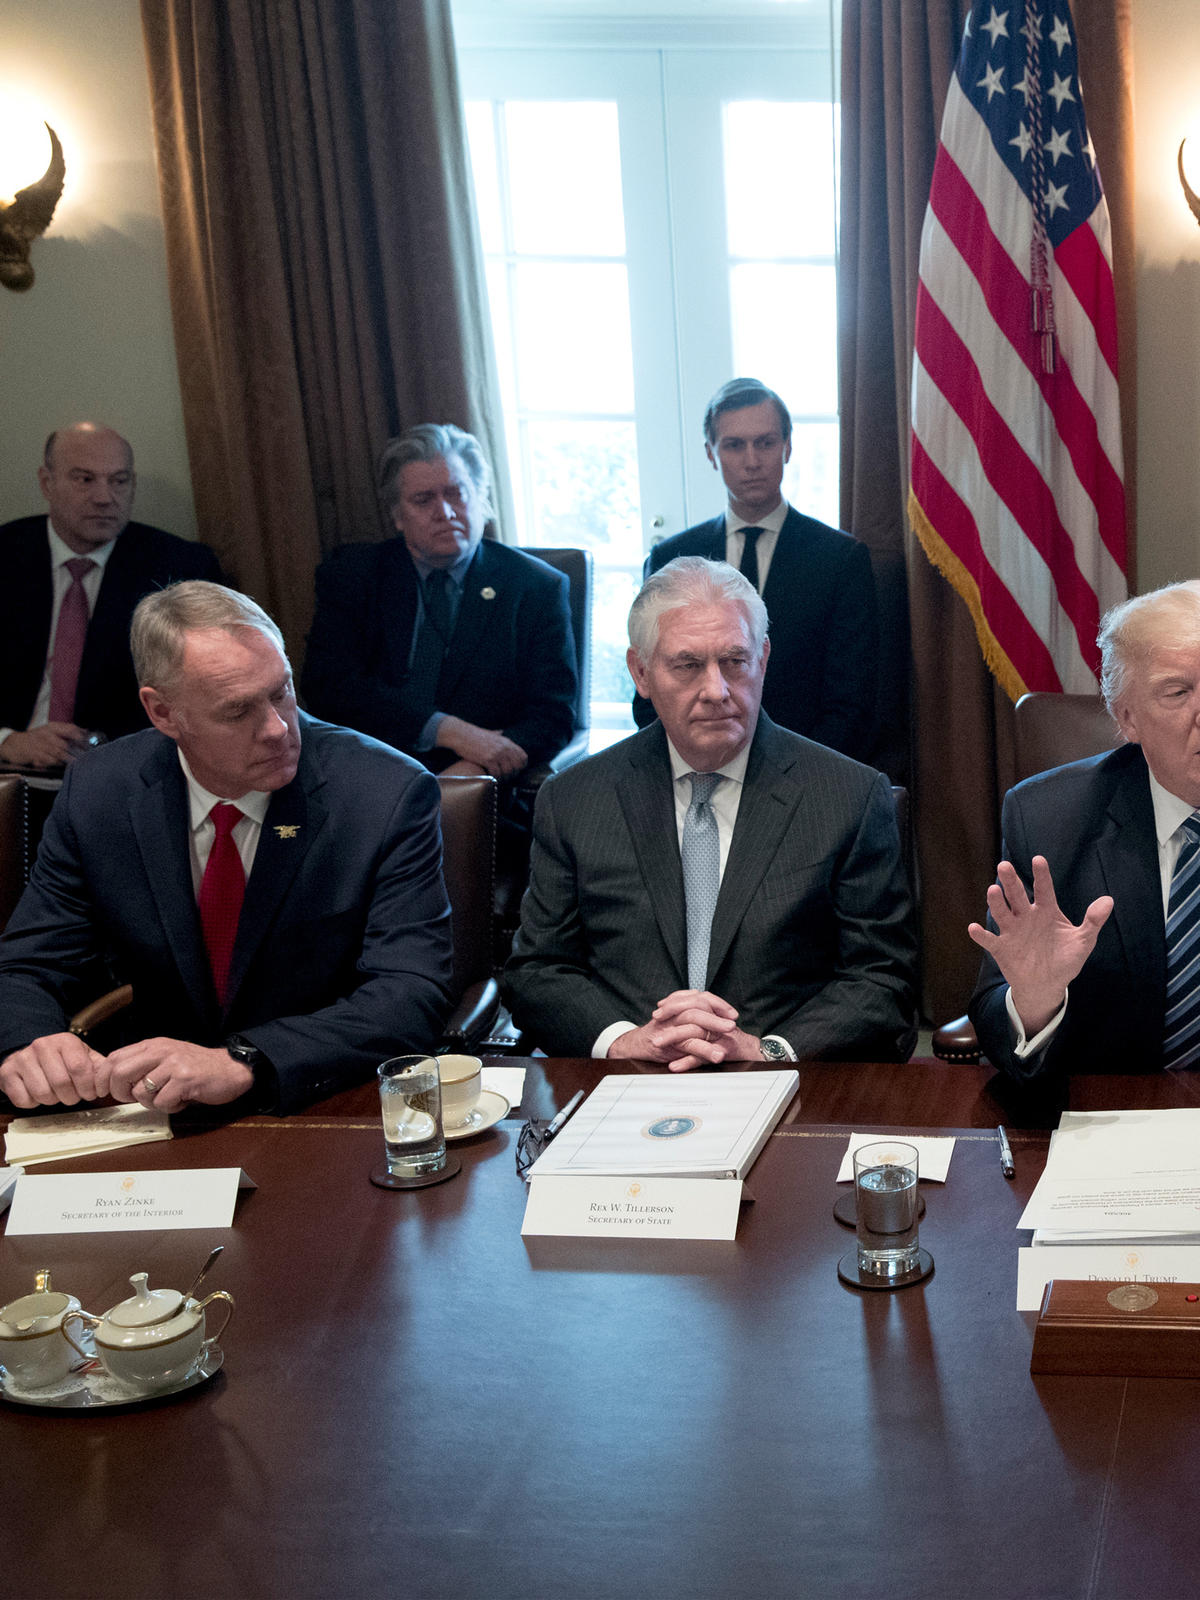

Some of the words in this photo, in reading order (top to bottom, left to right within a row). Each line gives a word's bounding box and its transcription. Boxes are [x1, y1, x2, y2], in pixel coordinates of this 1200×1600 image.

[95, 1198, 122, 1207] RYAN
[123, 1197, 155, 1206] ZINKE
[589, 1203, 608, 1213] REX
[610, 1203, 623, 1213] W.
[625, 1203, 675, 1214] TILLERSON
[61, 1211, 109, 1220] SECRETARY
[143, 1208, 184, 1217] INTERIOR
[587, 1215, 633, 1225] SECRETARY
[647, 1215, 672, 1225] STATE
